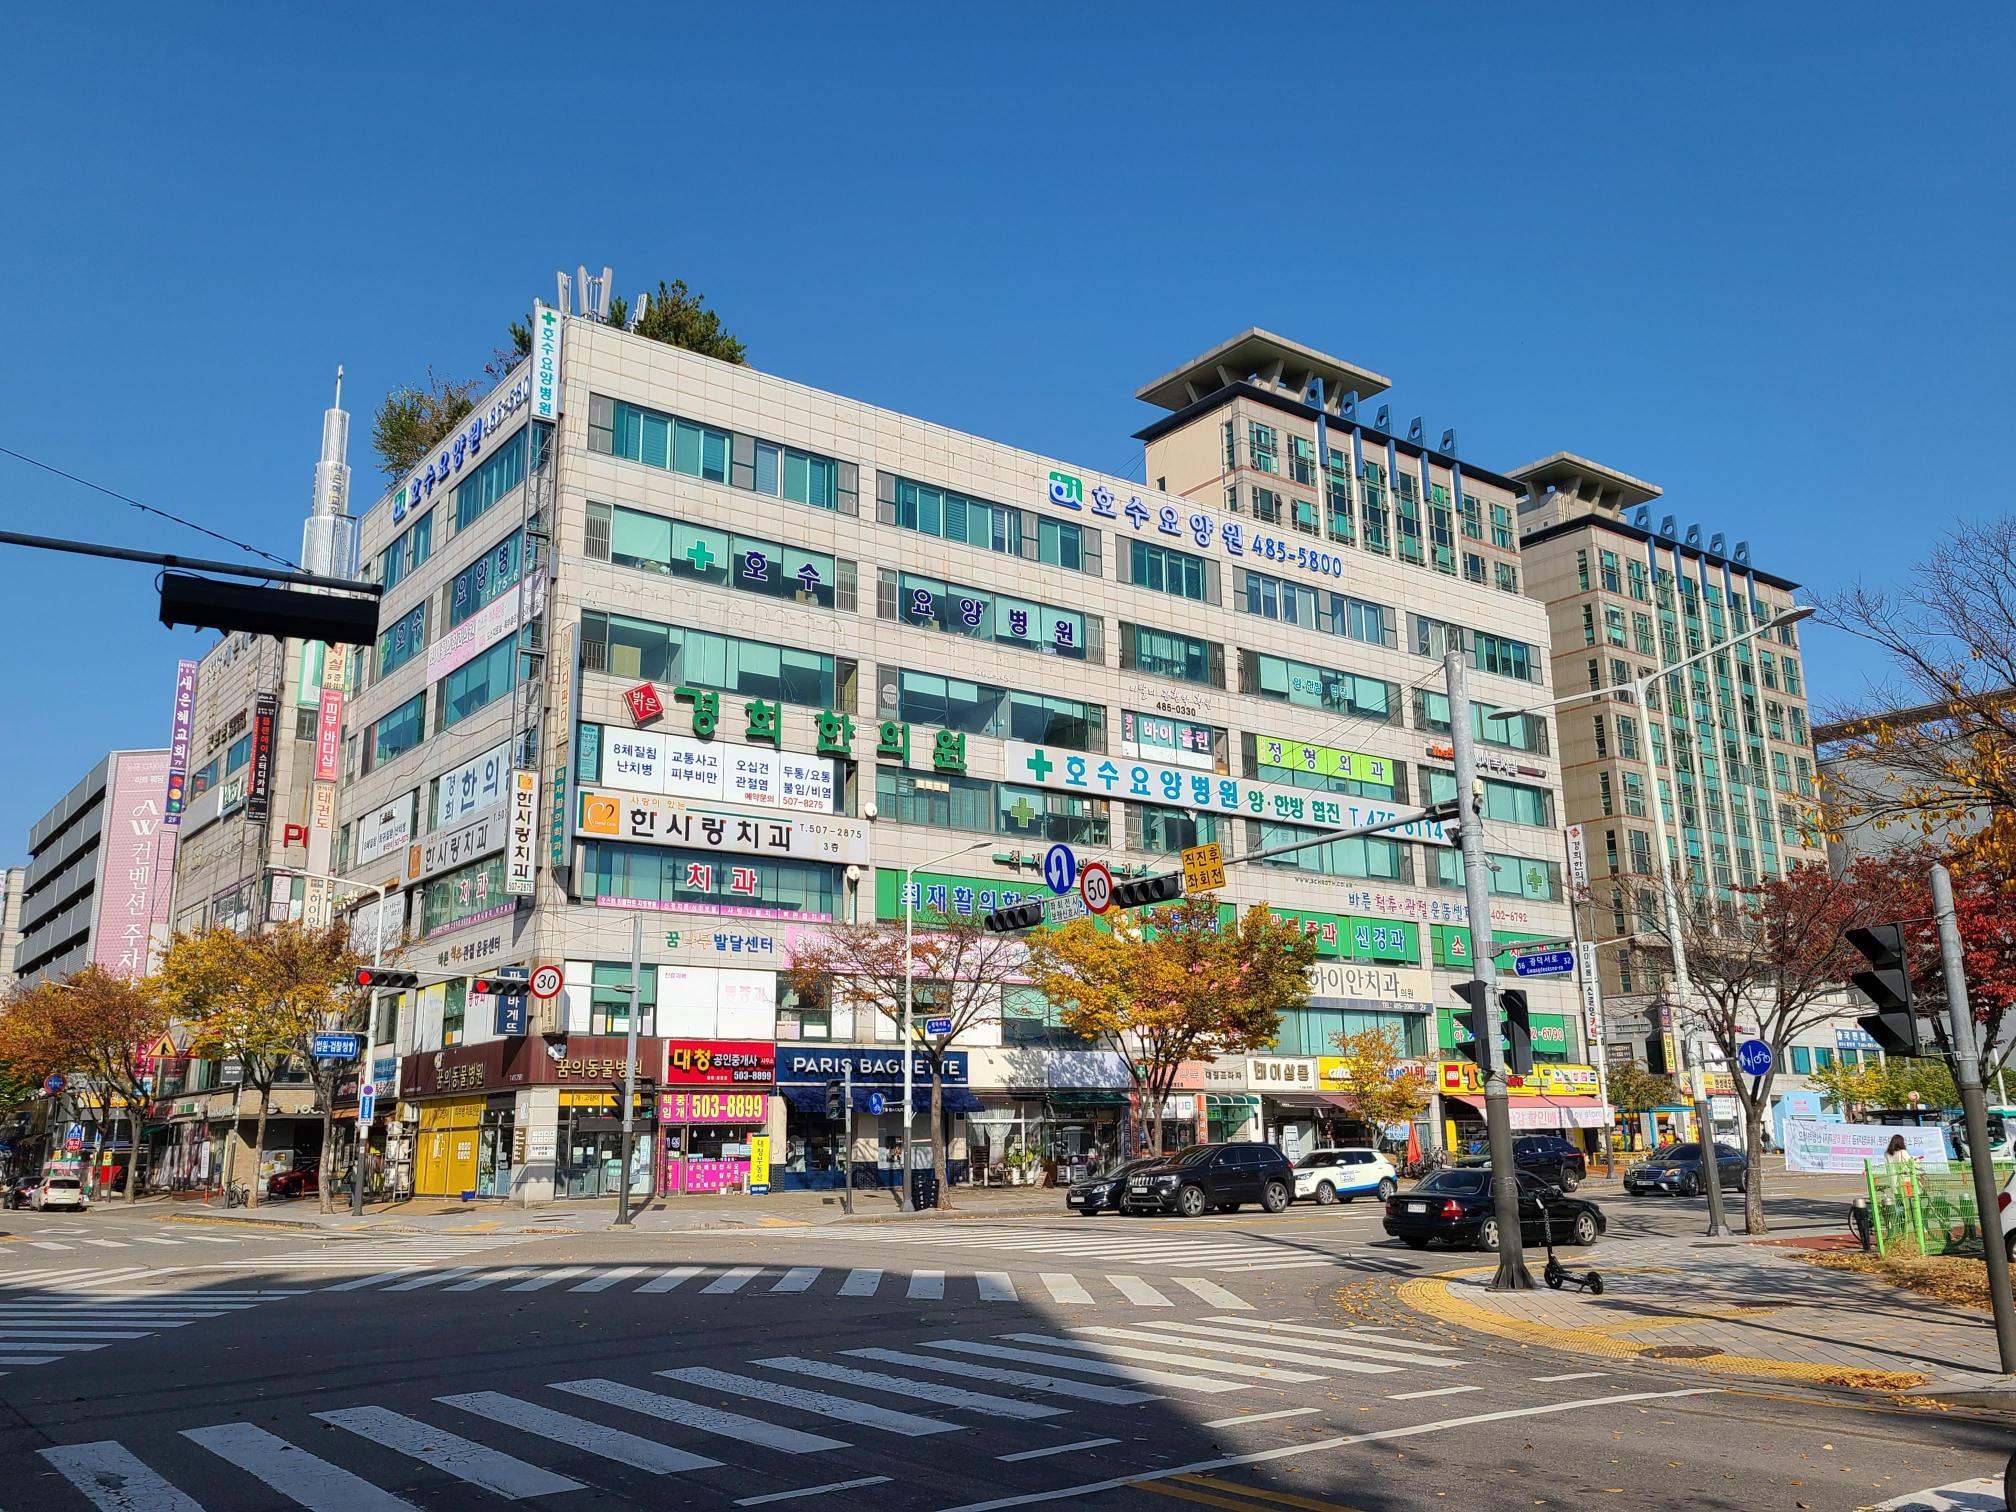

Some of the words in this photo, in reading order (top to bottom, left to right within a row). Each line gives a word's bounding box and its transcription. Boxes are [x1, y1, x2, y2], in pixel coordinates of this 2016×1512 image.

[540, 328, 555, 417] 호수요양병원
[410, 417, 483, 509] 호수요양원
[483, 374, 530, 437] 485-580
[1091, 486, 1244, 556] 호수요양원
[1251, 534, 1342, 578] 485-5800
[743, 550, 821, 592] 호수
[912, 587, 1074, 648] 요양병원
[632, 689, 658, 713] 밝은
[1156, 702, 1196, 717] 485-0330
[173, 675, 193, 760] 새은혜교회
[325, 702, 338, 728] 피부
[674, 687, 968, 772] 경희한의원
[321, 731, 335, 767] 바디샵
[613, 743, 657, 760] 8체질침
[671, 750, 718, 768] 교통사고
[616, 759, 653, 777] 난치병
[735, 759, 769, 776] 오십견
[1267, 741, 1385, 782] 정형외과
[256, 753, 268, 796] 스터디카페
[670, 767, 718, 785] 피부비만
[735, 775, 769, 792] 관절염
[783, 767, 832, 784] 두통/요통
[631, 796, 660, 808] 사랑이
[783, 782, 832, 800] 불임/비염
[1065, 755, 1239, 810] 호수요양병원
[1248, 790, 1304, 819] 양·한방
[1311, 800, 1342, 825] 협진
[315, 791, 331, 829] 태권도
[783, 796, 824, 810] 507-8275
[167, 816, 178, 824] 2F
[630, 808, 793, 852] 한사랑치과
[799, 822, 863, 840] T.507-2875
[512, 791, 533, 879] 한사랑치과
[823, 841, 840, 853] 3층
[425, 823, 489, 873] 한사랑치과
[1184, 848, 1220, 867] 직진후
[127, 841, 151, 917] 컨벤션
[460, 872, 489, 907] 치과
[686, 863, 758, 896] 치과
[1087, 877, 1107, 901] 50
[1187, 867, 1224, 889] 좌회전
[1348, 892, 1372, 910] 바른
[1490, 909, 1528, 923] 402-6792
[1355, 925, 1405, 952] 신경과
[1517, 962, 1526, 970] 36
[1528, 954, 1559, 967] 광덕서로
[1563, 957, 1572, 965] 32
[536, 974, 557, 990] 30
[1400, 988, 1415, 999] 의원
[504, 971, 522, 1033] 파바게뜨
[673, 1048, 712, 1072] 대청
[713, 1053, 758, 1067] 공인중개사
[793, 1057, 853, 1074] PARIS
[436, 1061, 485, 1090] 꿈의동물병원
[733, 1070, 773, 1081] 503-8899
[691, 1094, 763, 1119] 503-8899
